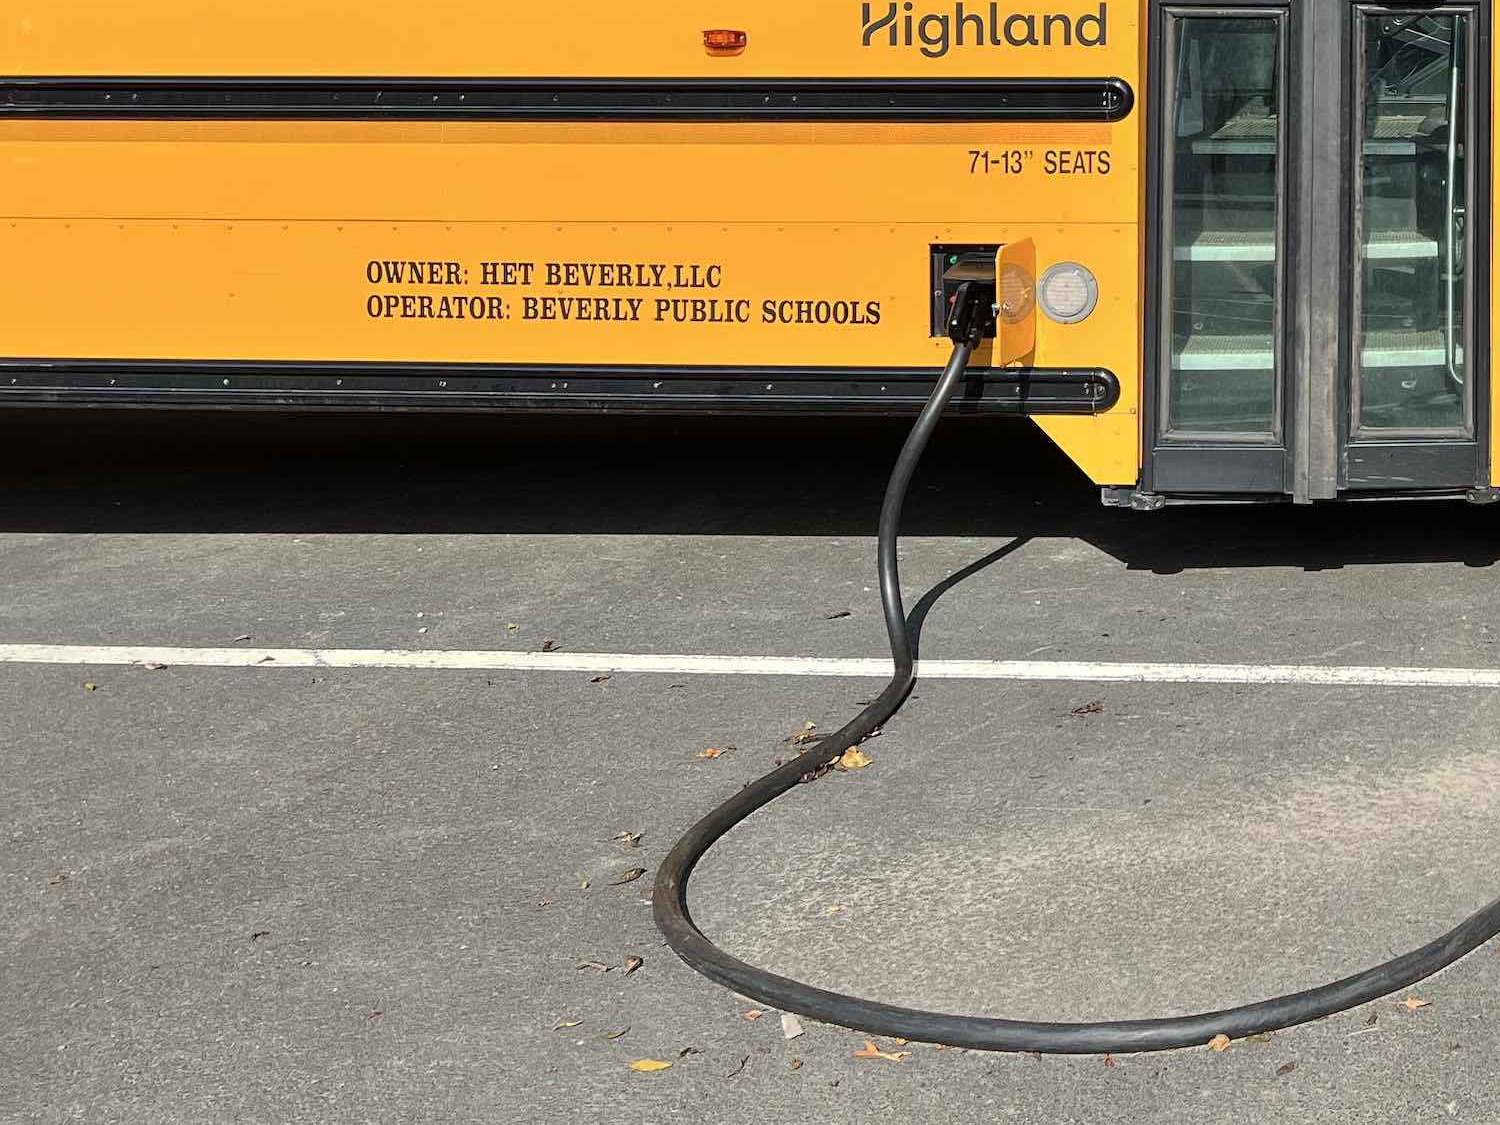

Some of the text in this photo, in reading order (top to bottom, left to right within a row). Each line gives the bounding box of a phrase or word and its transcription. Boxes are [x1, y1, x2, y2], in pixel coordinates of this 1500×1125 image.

[862, 2, 1107, 59] Highland
[1044, 150, 1111, 175] SEATS
[366, 261, 468, 286] OWNER:
[480, 262, 534, 286] HET
[366, 295, 881, 326] OPERATOR: BEVERLY PUBLIC SCHOOLS
